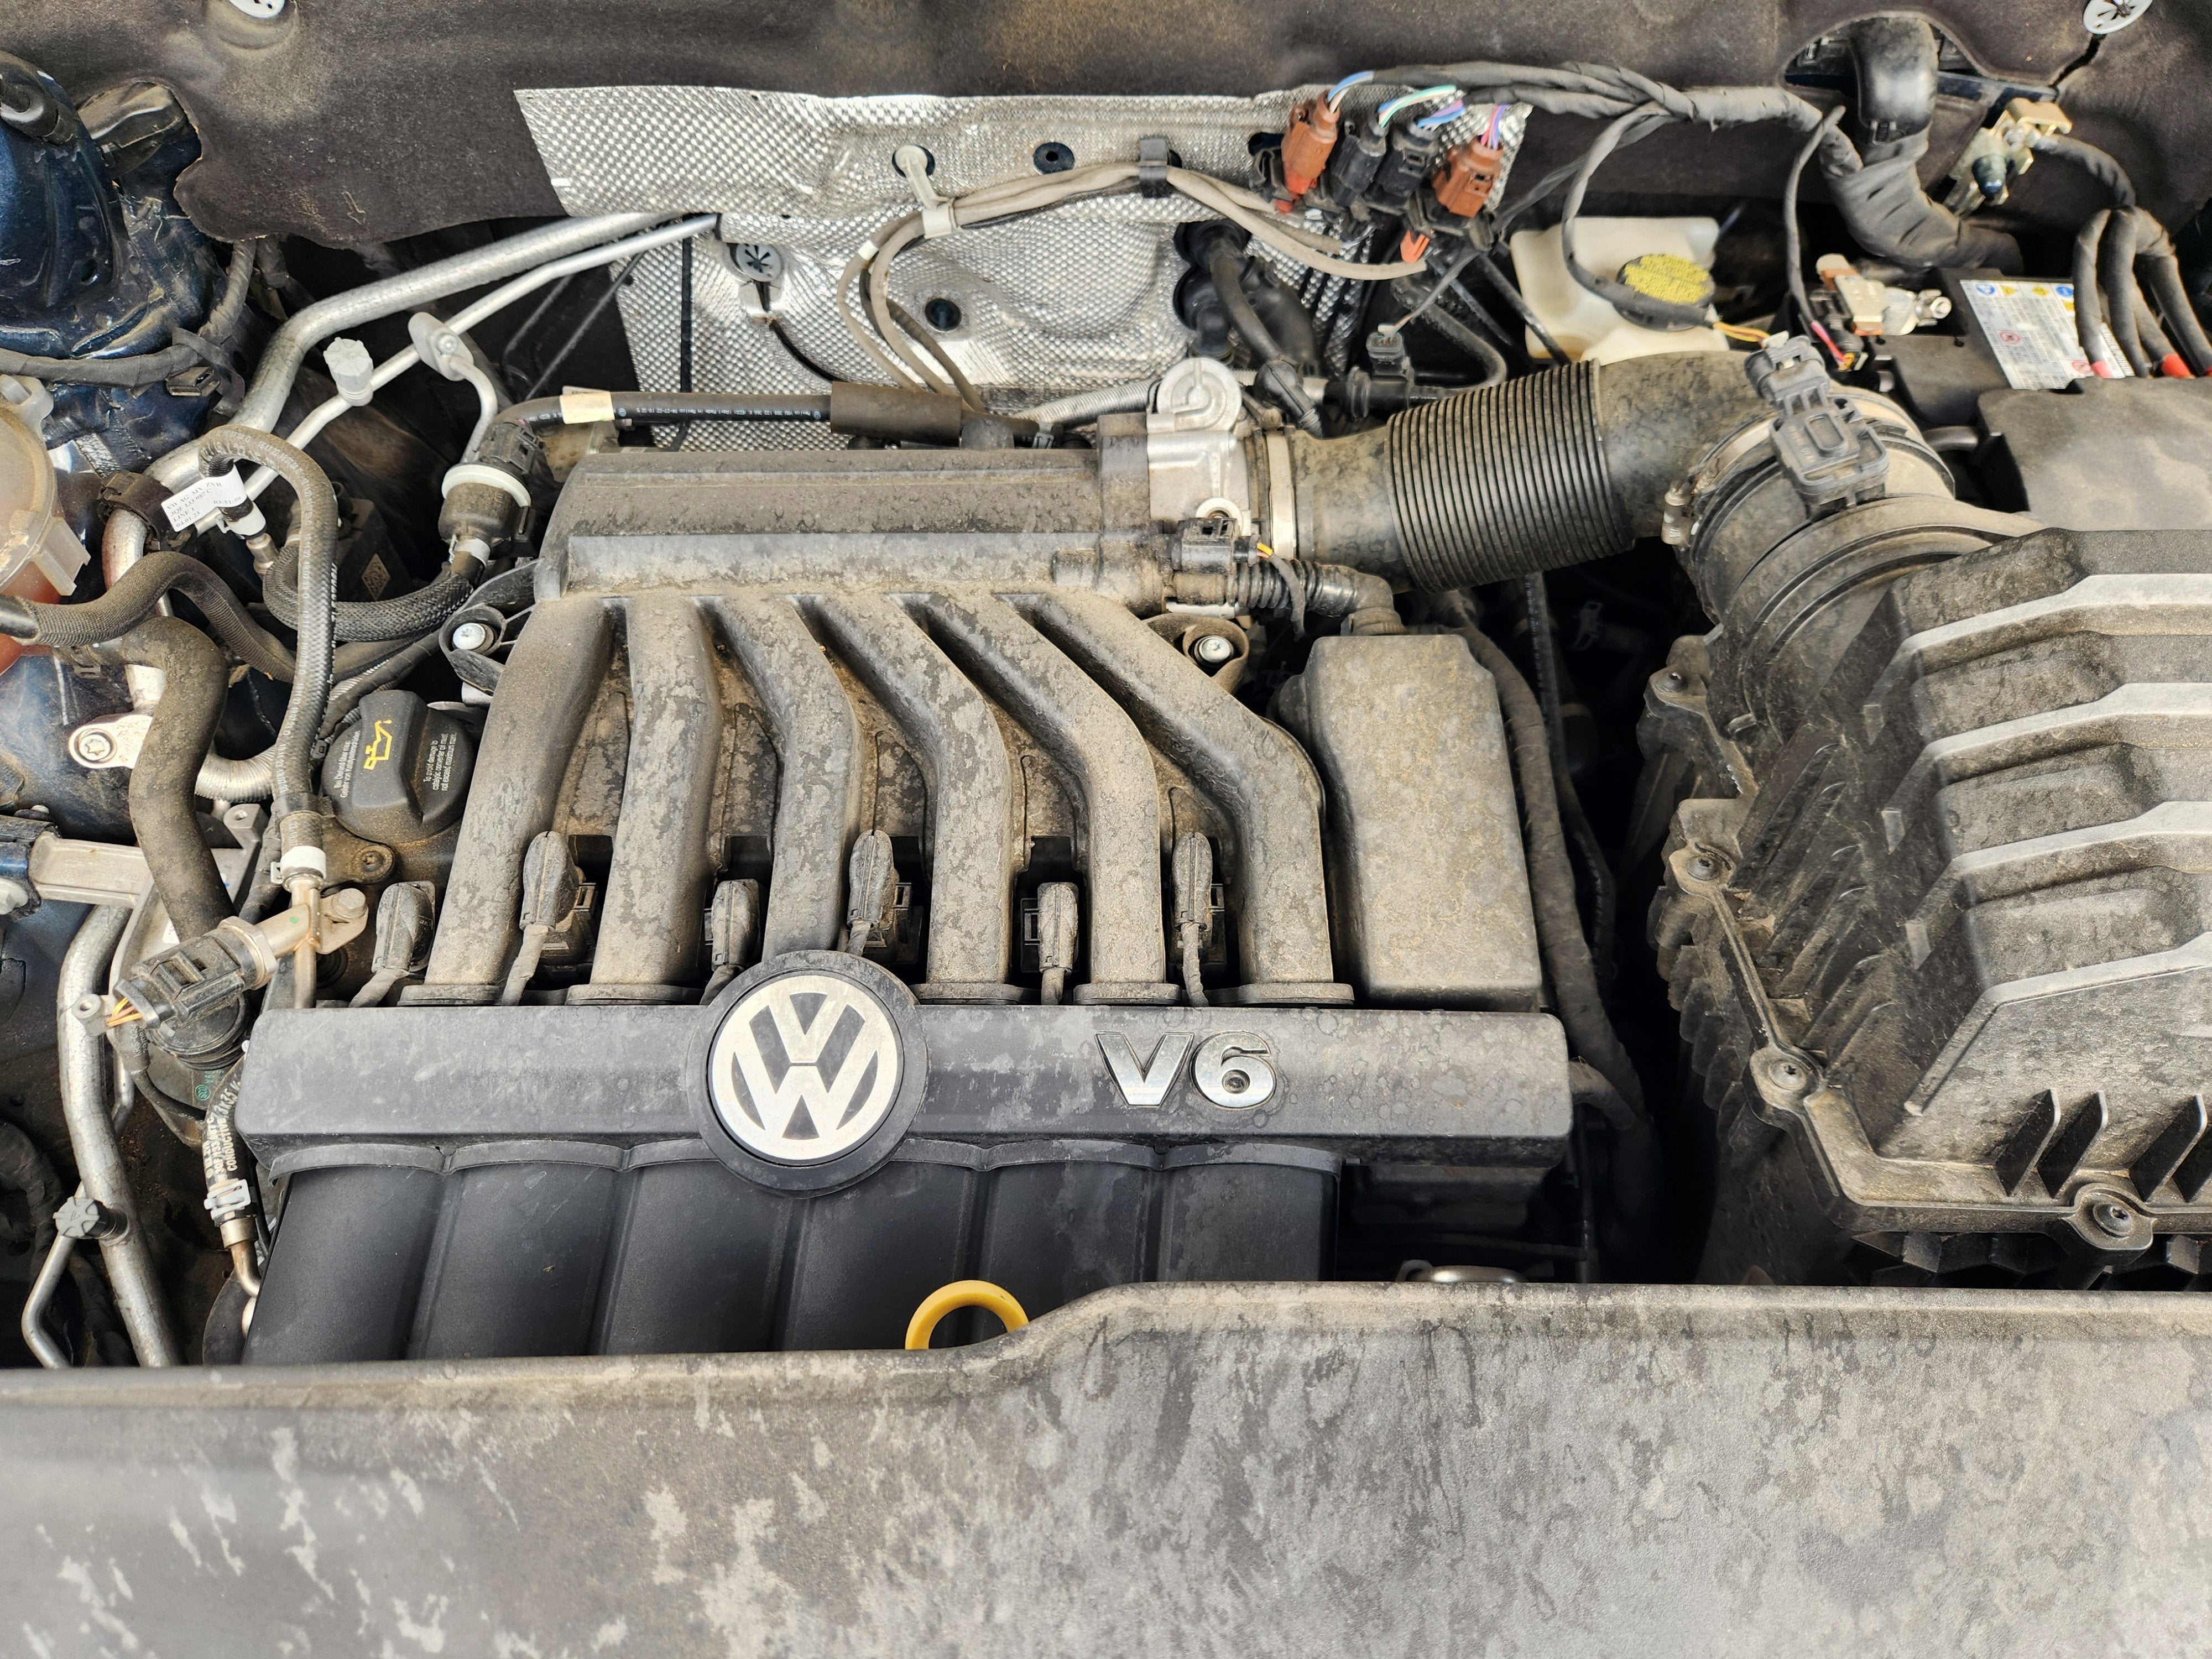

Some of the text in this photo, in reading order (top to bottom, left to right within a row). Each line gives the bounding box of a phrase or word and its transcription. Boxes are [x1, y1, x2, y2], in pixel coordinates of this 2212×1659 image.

[173, 510, 190, 522] LINE
[427, 745, 438, 763] damage
[435, 750, 445, 771] converter
[445, 745, 455, 765] maximum
[432, 771, 442, 790] catalytic
[712, 975, 898, 1160] VW
[1094, 1030, 1277, 1110] V6
[217, 1117, 238, 1171] CONDUCTIVE
